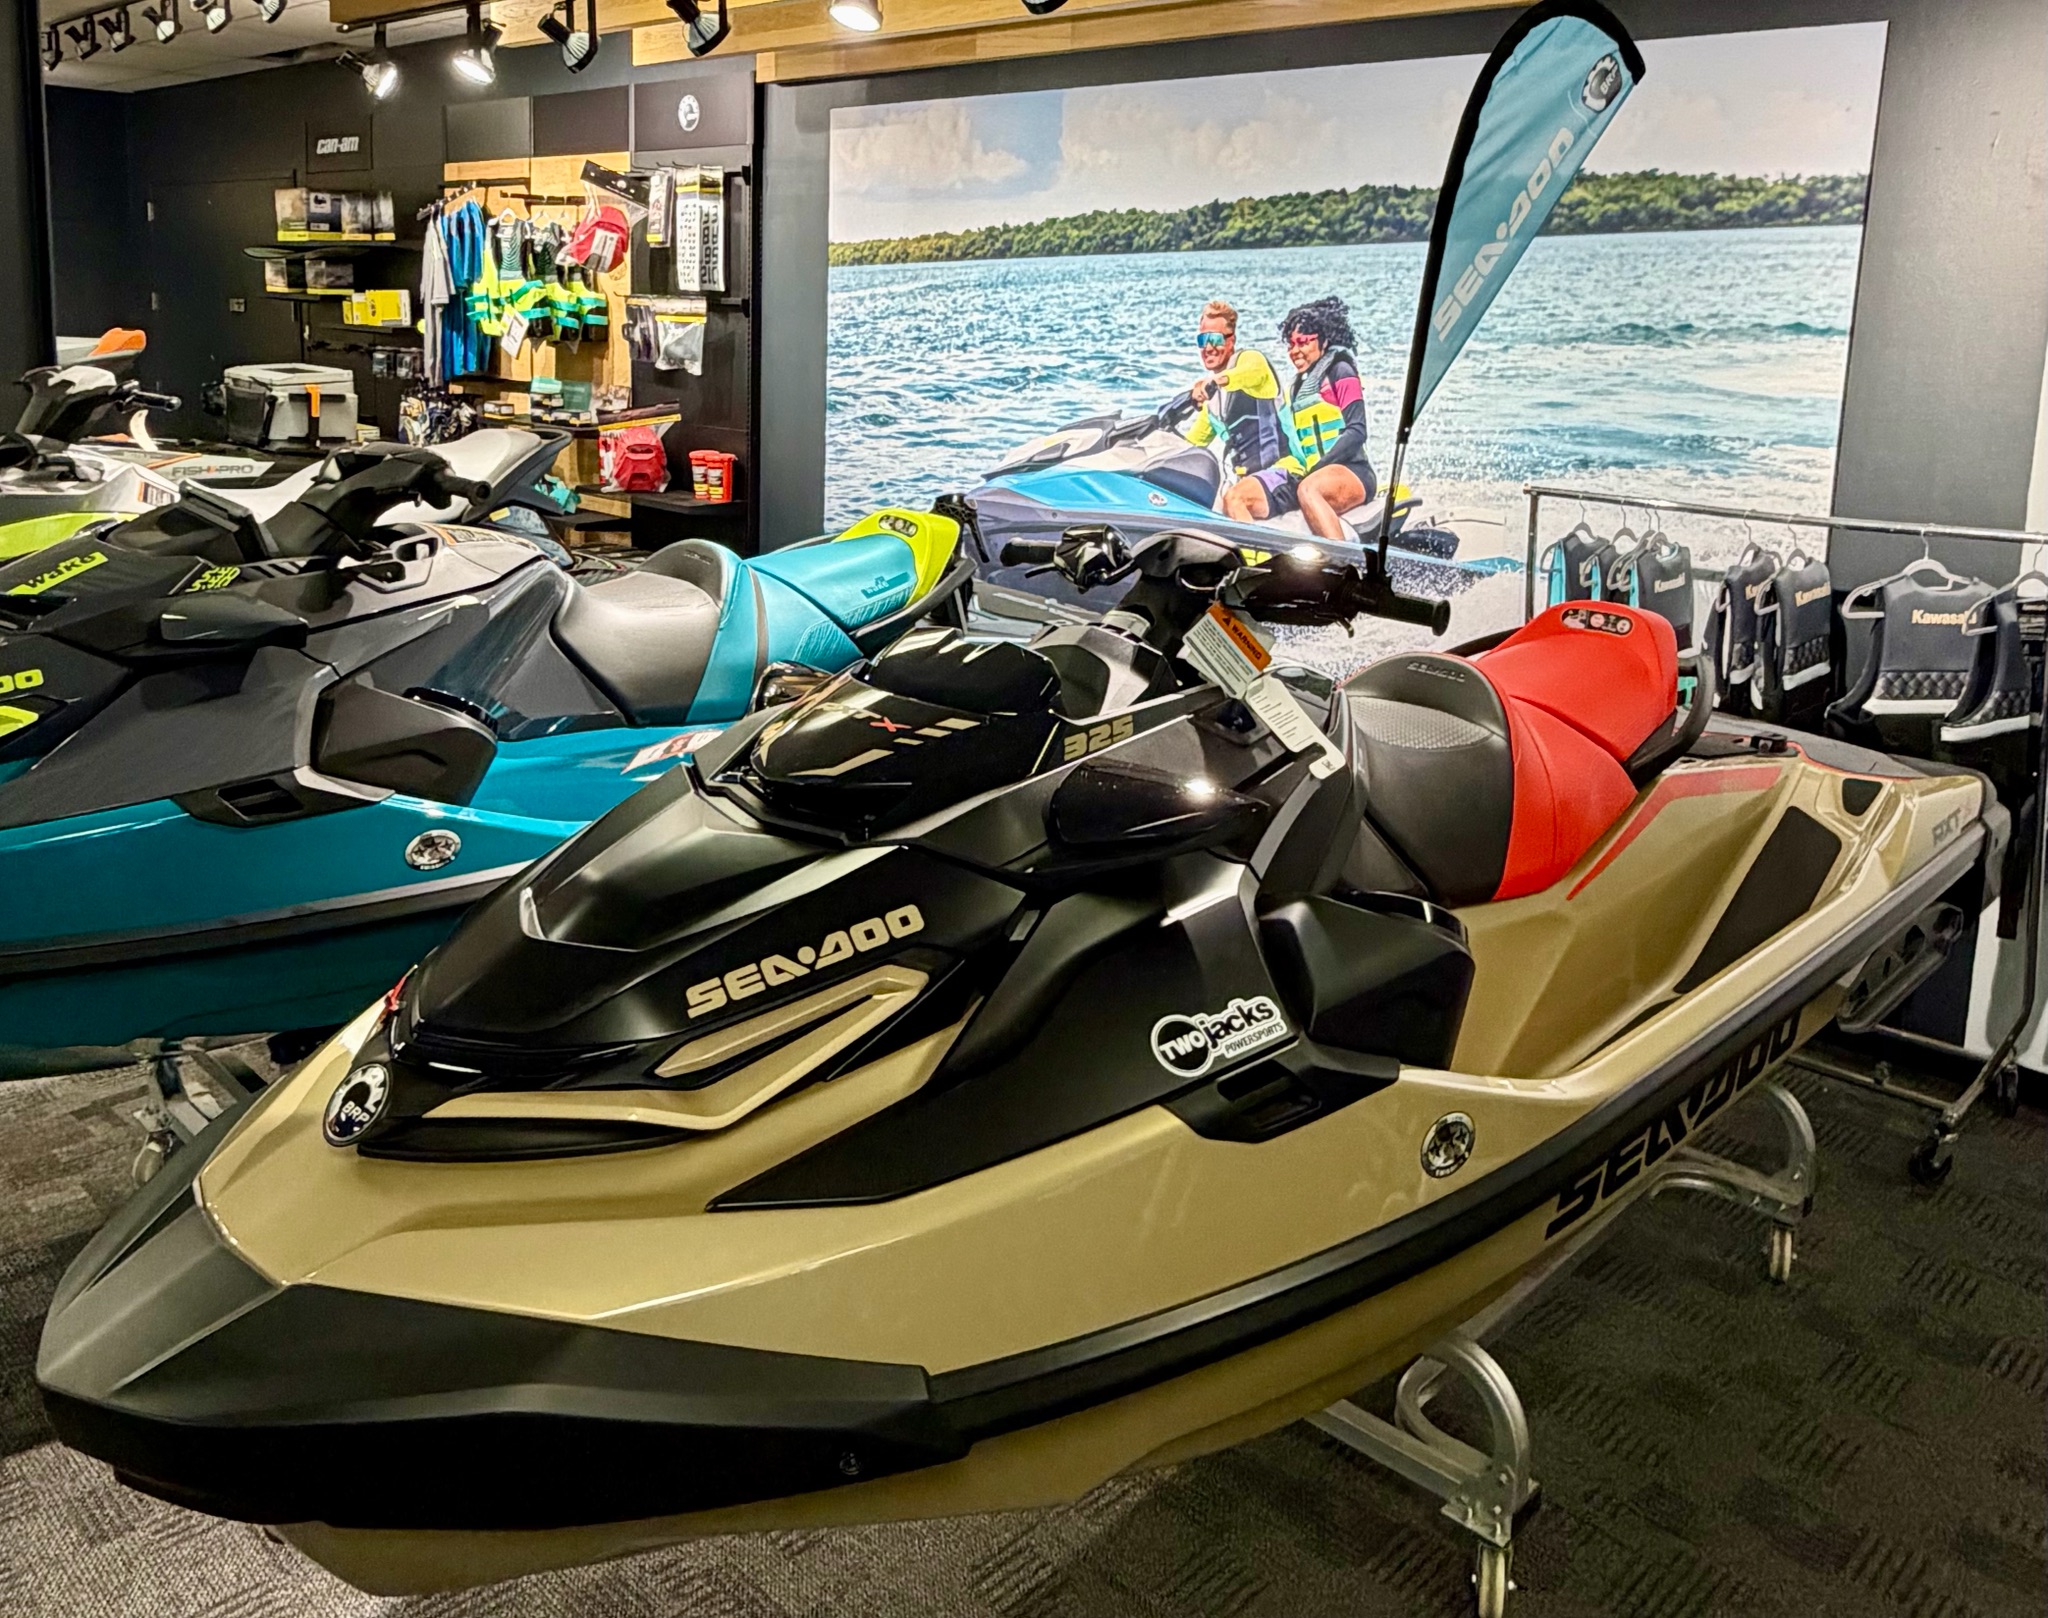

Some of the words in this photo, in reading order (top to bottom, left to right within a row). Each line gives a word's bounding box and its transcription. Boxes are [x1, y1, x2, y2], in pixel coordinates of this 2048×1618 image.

[316, 136, 360, 154] can-am
[1231, 624, 1263, 660] WARNING
[1064, 714, 1133, 761] 325
[1159, 1030, 1206, 1060] TWO
[1198, 1002, 1275, 1049] jacks
[1224, 1021, 1285, 1055] POWERSPORTS
[342, 1100, 370, 1122] BRP
